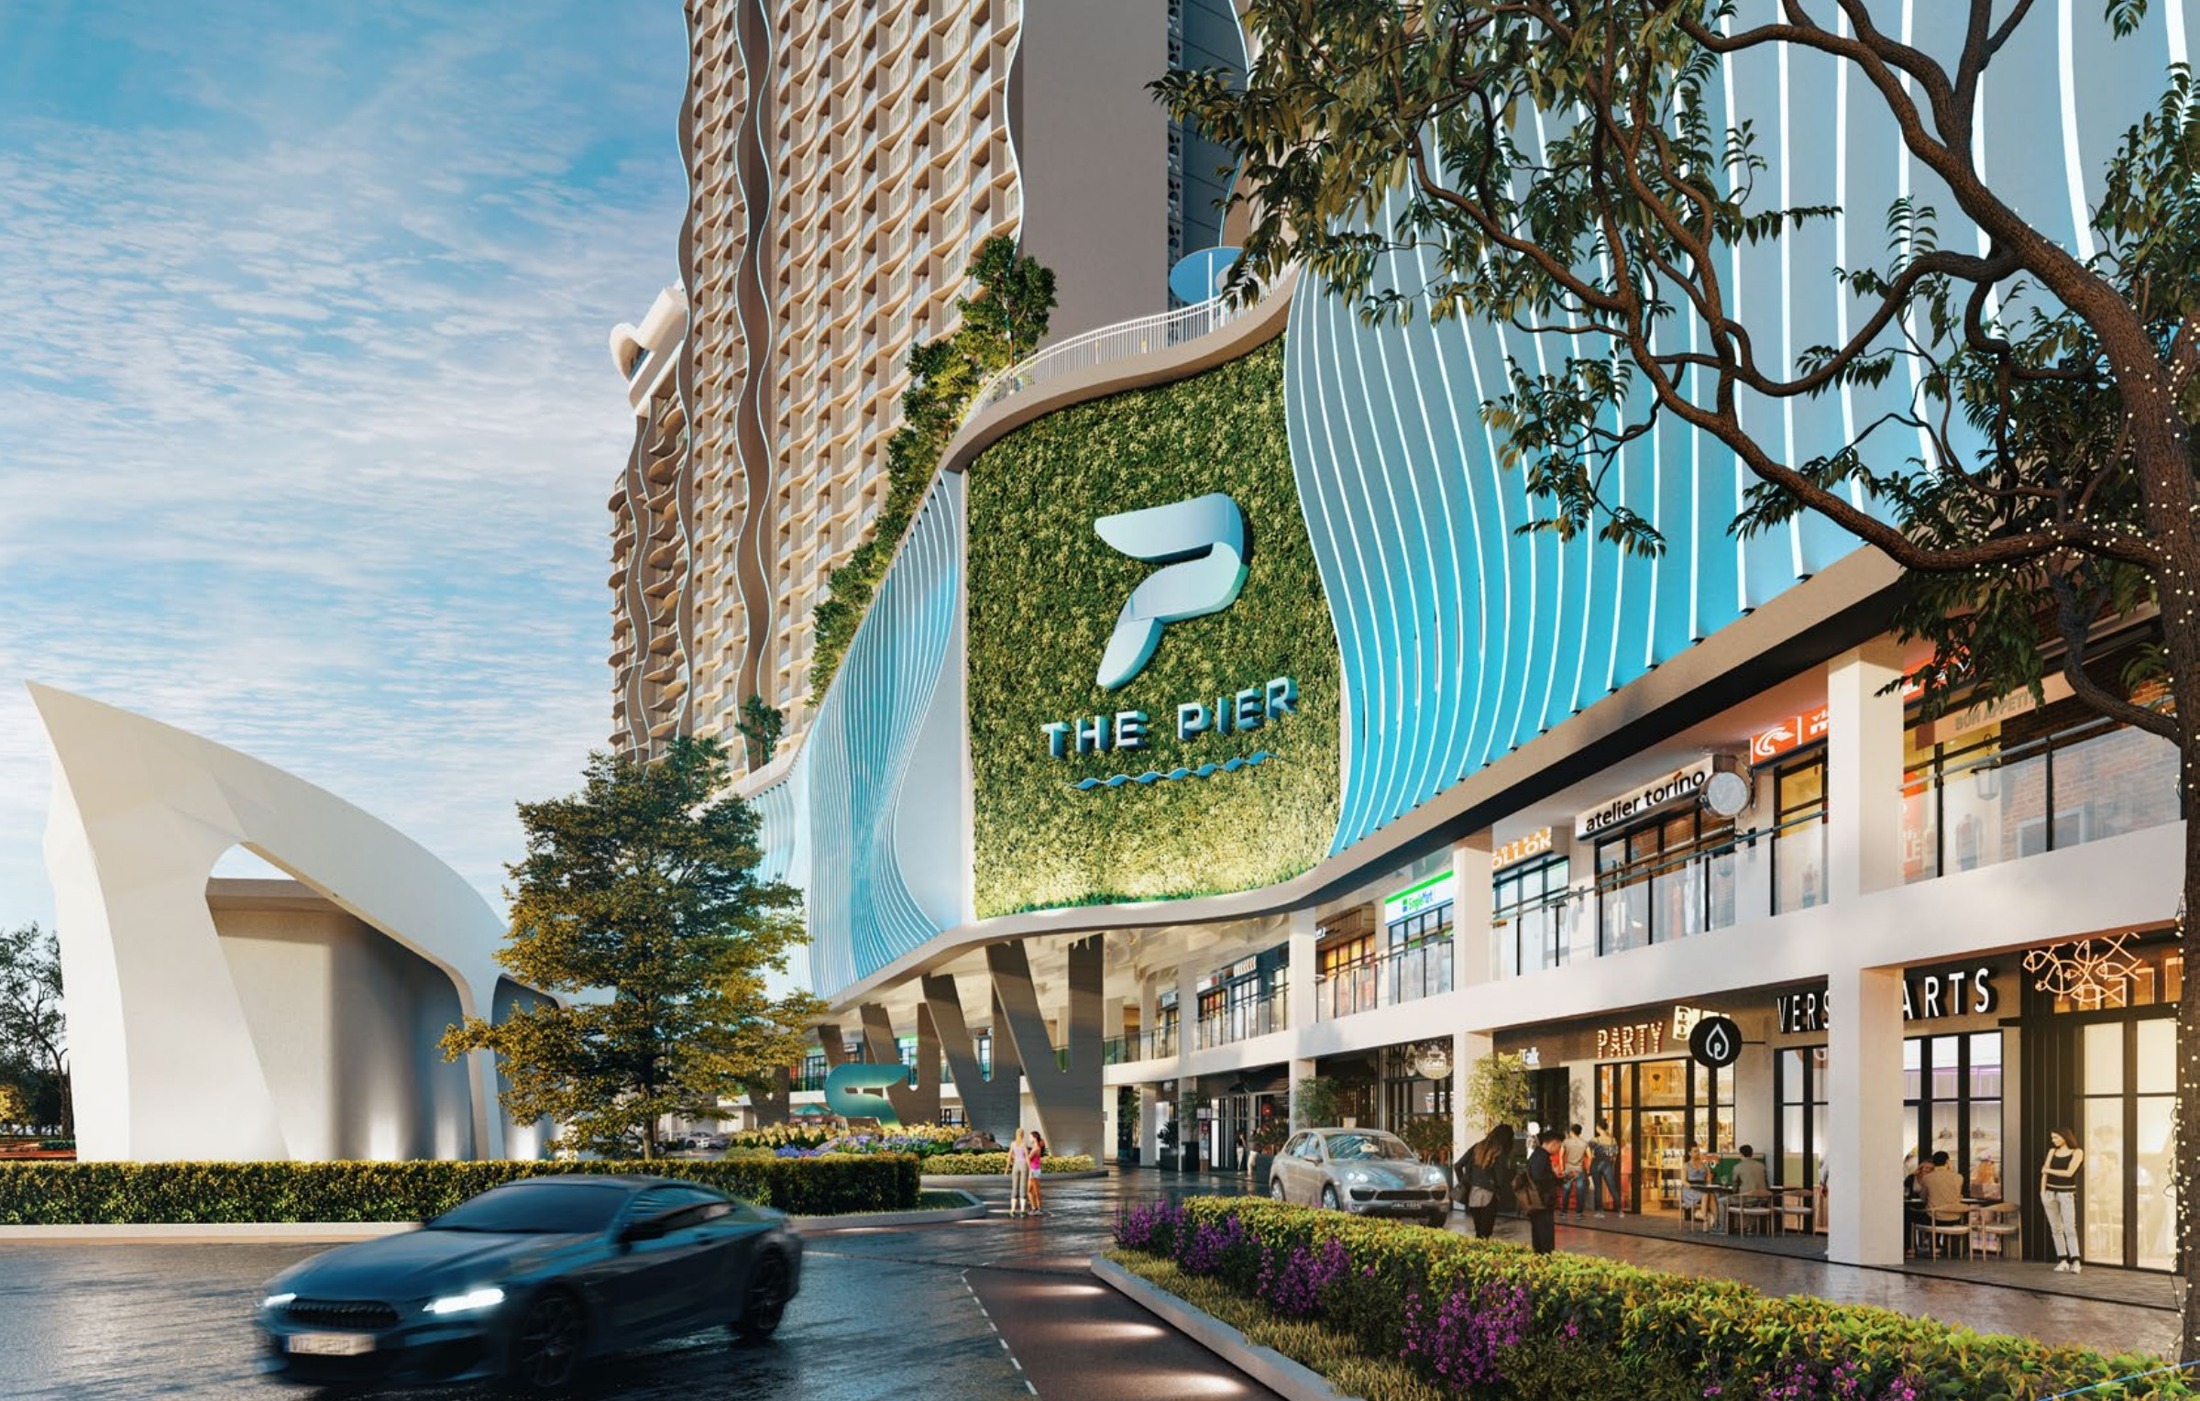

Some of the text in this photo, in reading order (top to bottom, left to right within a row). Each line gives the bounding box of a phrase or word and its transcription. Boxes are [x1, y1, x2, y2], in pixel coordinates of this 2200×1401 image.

[1041, 677, 1298, 759] THE PIER
[1586, 797, 1640, 832] atelier
[1598, 1021, 1663, 1058] PARTY
